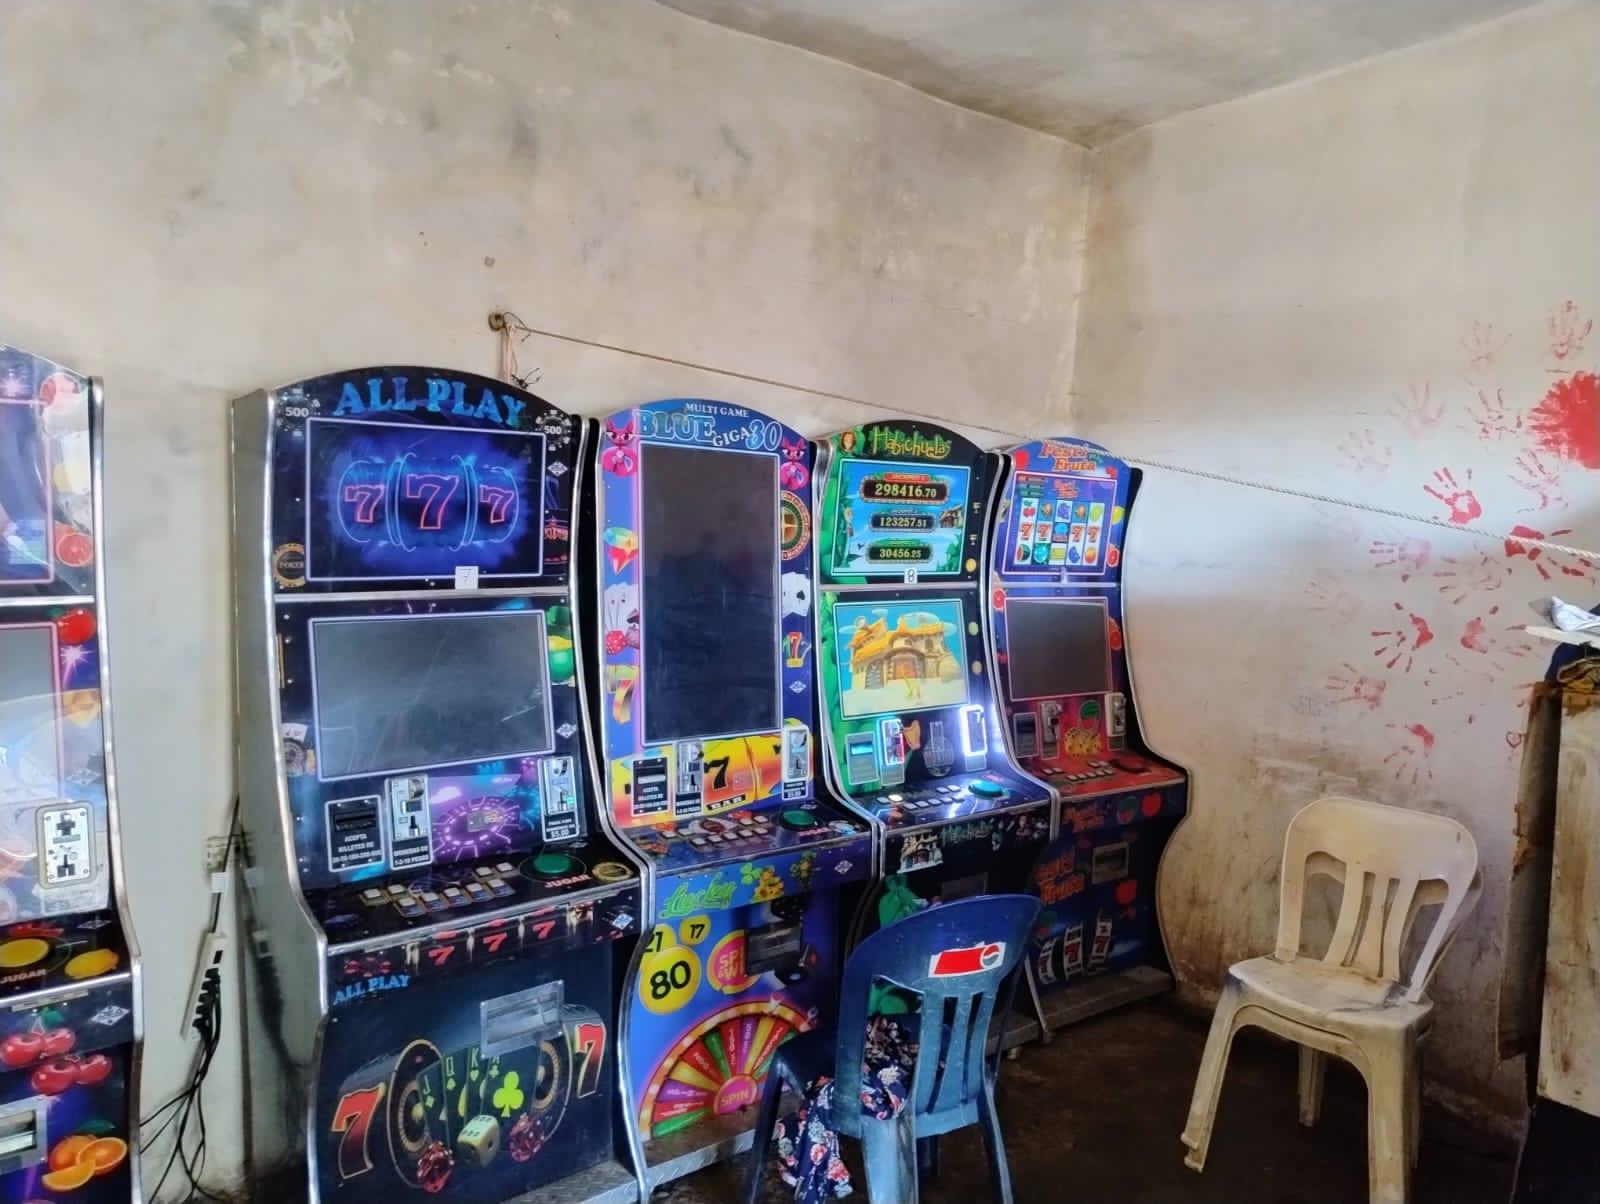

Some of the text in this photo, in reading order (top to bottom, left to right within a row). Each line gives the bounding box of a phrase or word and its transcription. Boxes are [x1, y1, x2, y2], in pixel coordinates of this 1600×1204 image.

[285, 406, 309, 417] 500
[333, 376, 527, 428] ALL PLAY
[685, 402, 749, 418] MULTI GAME
[544, 424, 562, 436] 500
[633, 410, 715, 442] BLUE
[874, 483, 937, 498] 298416.70
[702, 755, 731, 791] 7
[544, 874, 592, 888] JUGAR
[690, 923, 706, 939] 17
[333, 974, 410, 1006] ALL PLAY
[650, 960, 691, 1001] 80
[576, 1023, 606, 1099] 7
[332, 1082, 386, 1180] 7
